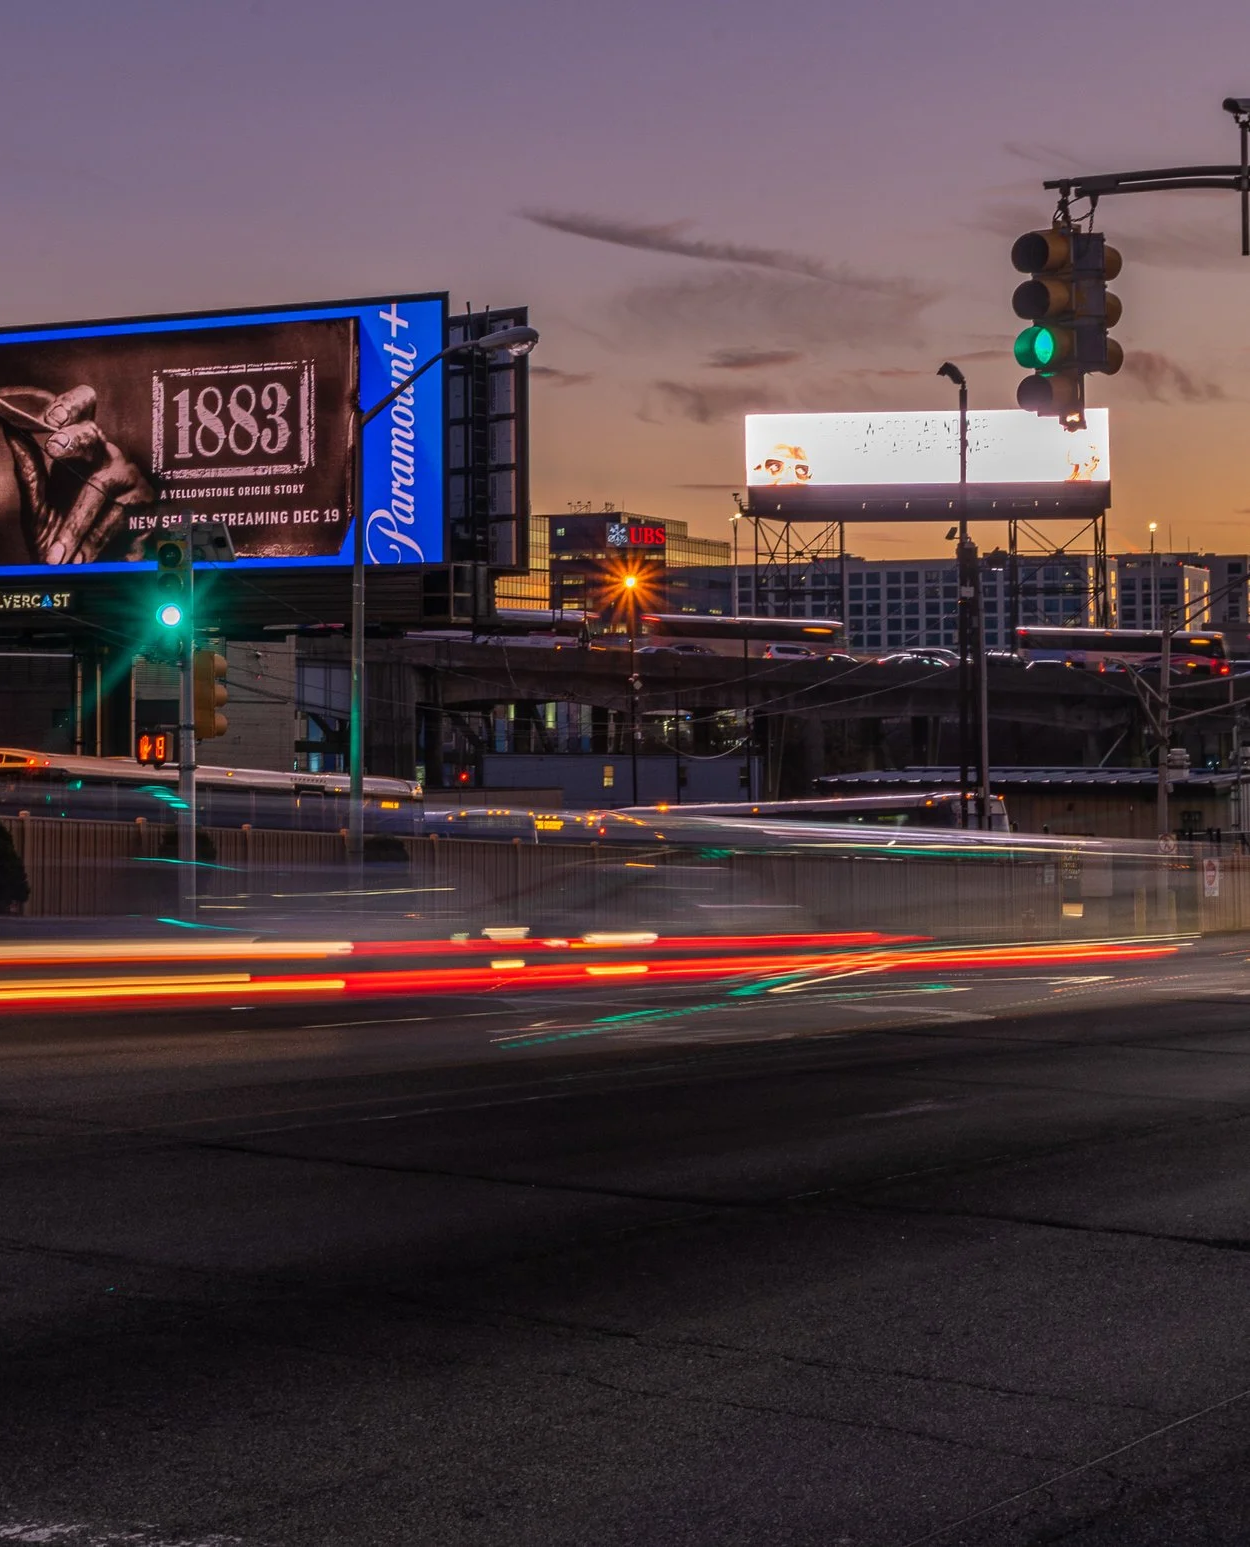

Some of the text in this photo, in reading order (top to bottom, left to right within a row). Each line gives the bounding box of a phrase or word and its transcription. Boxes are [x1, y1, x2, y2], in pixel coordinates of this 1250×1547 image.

[172, 382, 291, 459] 1883
[160, 484, 305, 500] A YELLOWSTONE ORIGIN STORY
[129, 509, 340, 530] NEW SEES STREAMING DEC 19
[630, 527, 666, 545] UBS
